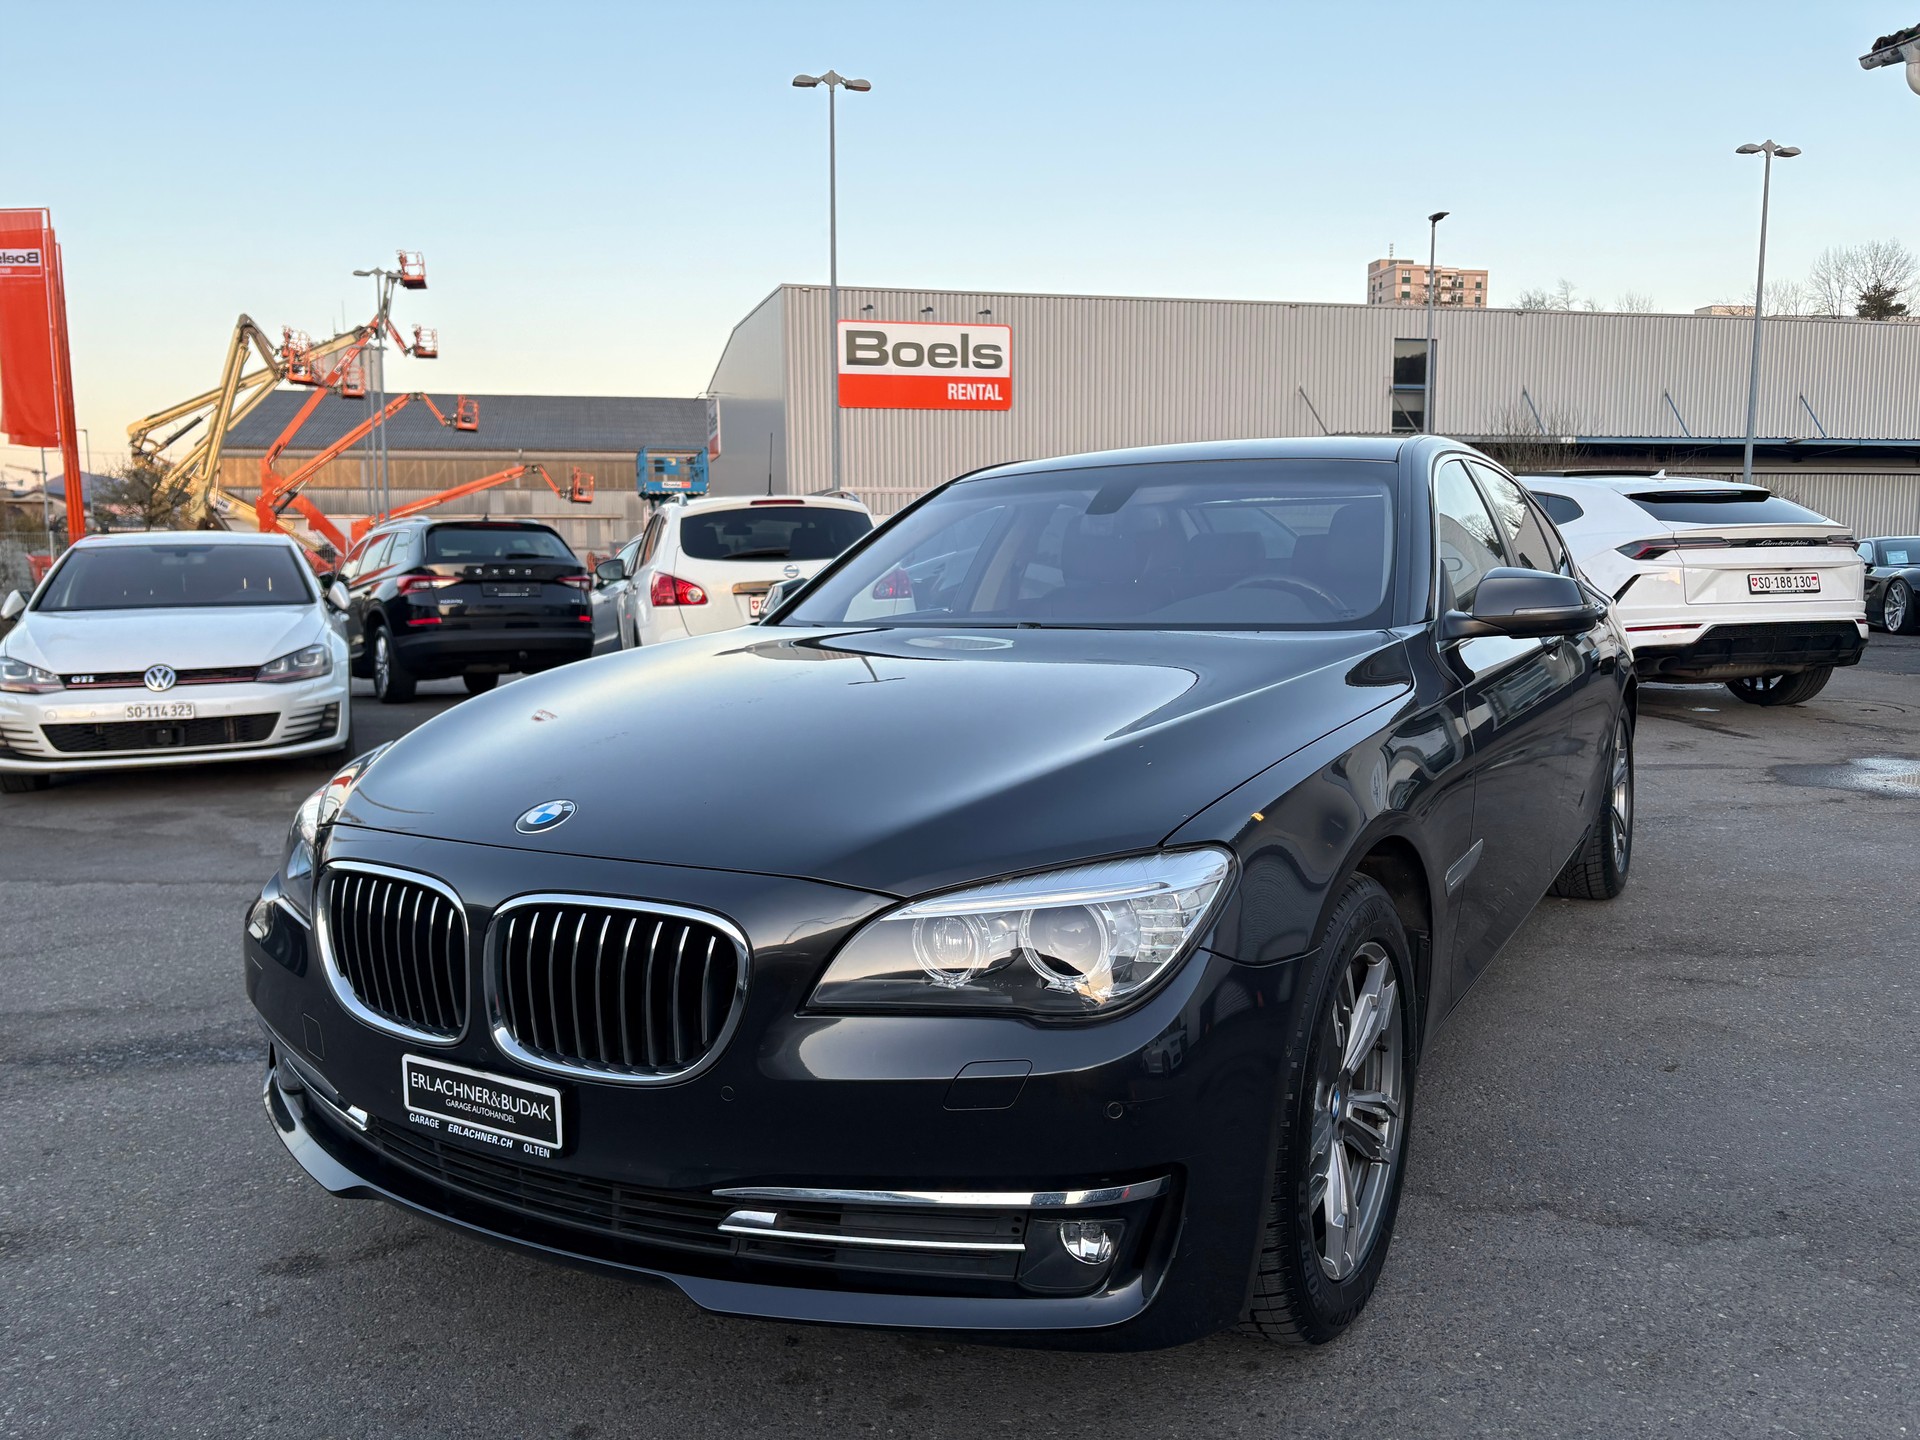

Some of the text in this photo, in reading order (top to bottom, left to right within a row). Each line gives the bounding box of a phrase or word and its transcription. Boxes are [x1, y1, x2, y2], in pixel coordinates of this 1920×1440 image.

[846, 330, 1003, 369] Boels
[947, 383, 1003, 401] RENTAL
[1756, 539, 1809, 547] Lamborghini
[1795, 575, 1811, 588] 130
[71, 675, 95, 684] GTI
[171, 705, 193, 717] 323
[411, 1072, 551, 1121] ERLACHNER&BUDAK
[445, 1098, 516, 1124] GARAGE AUTOHANDEL
[409, 1113, 550, 1158] GARAGE ERLACHNER.CH OLTEN
